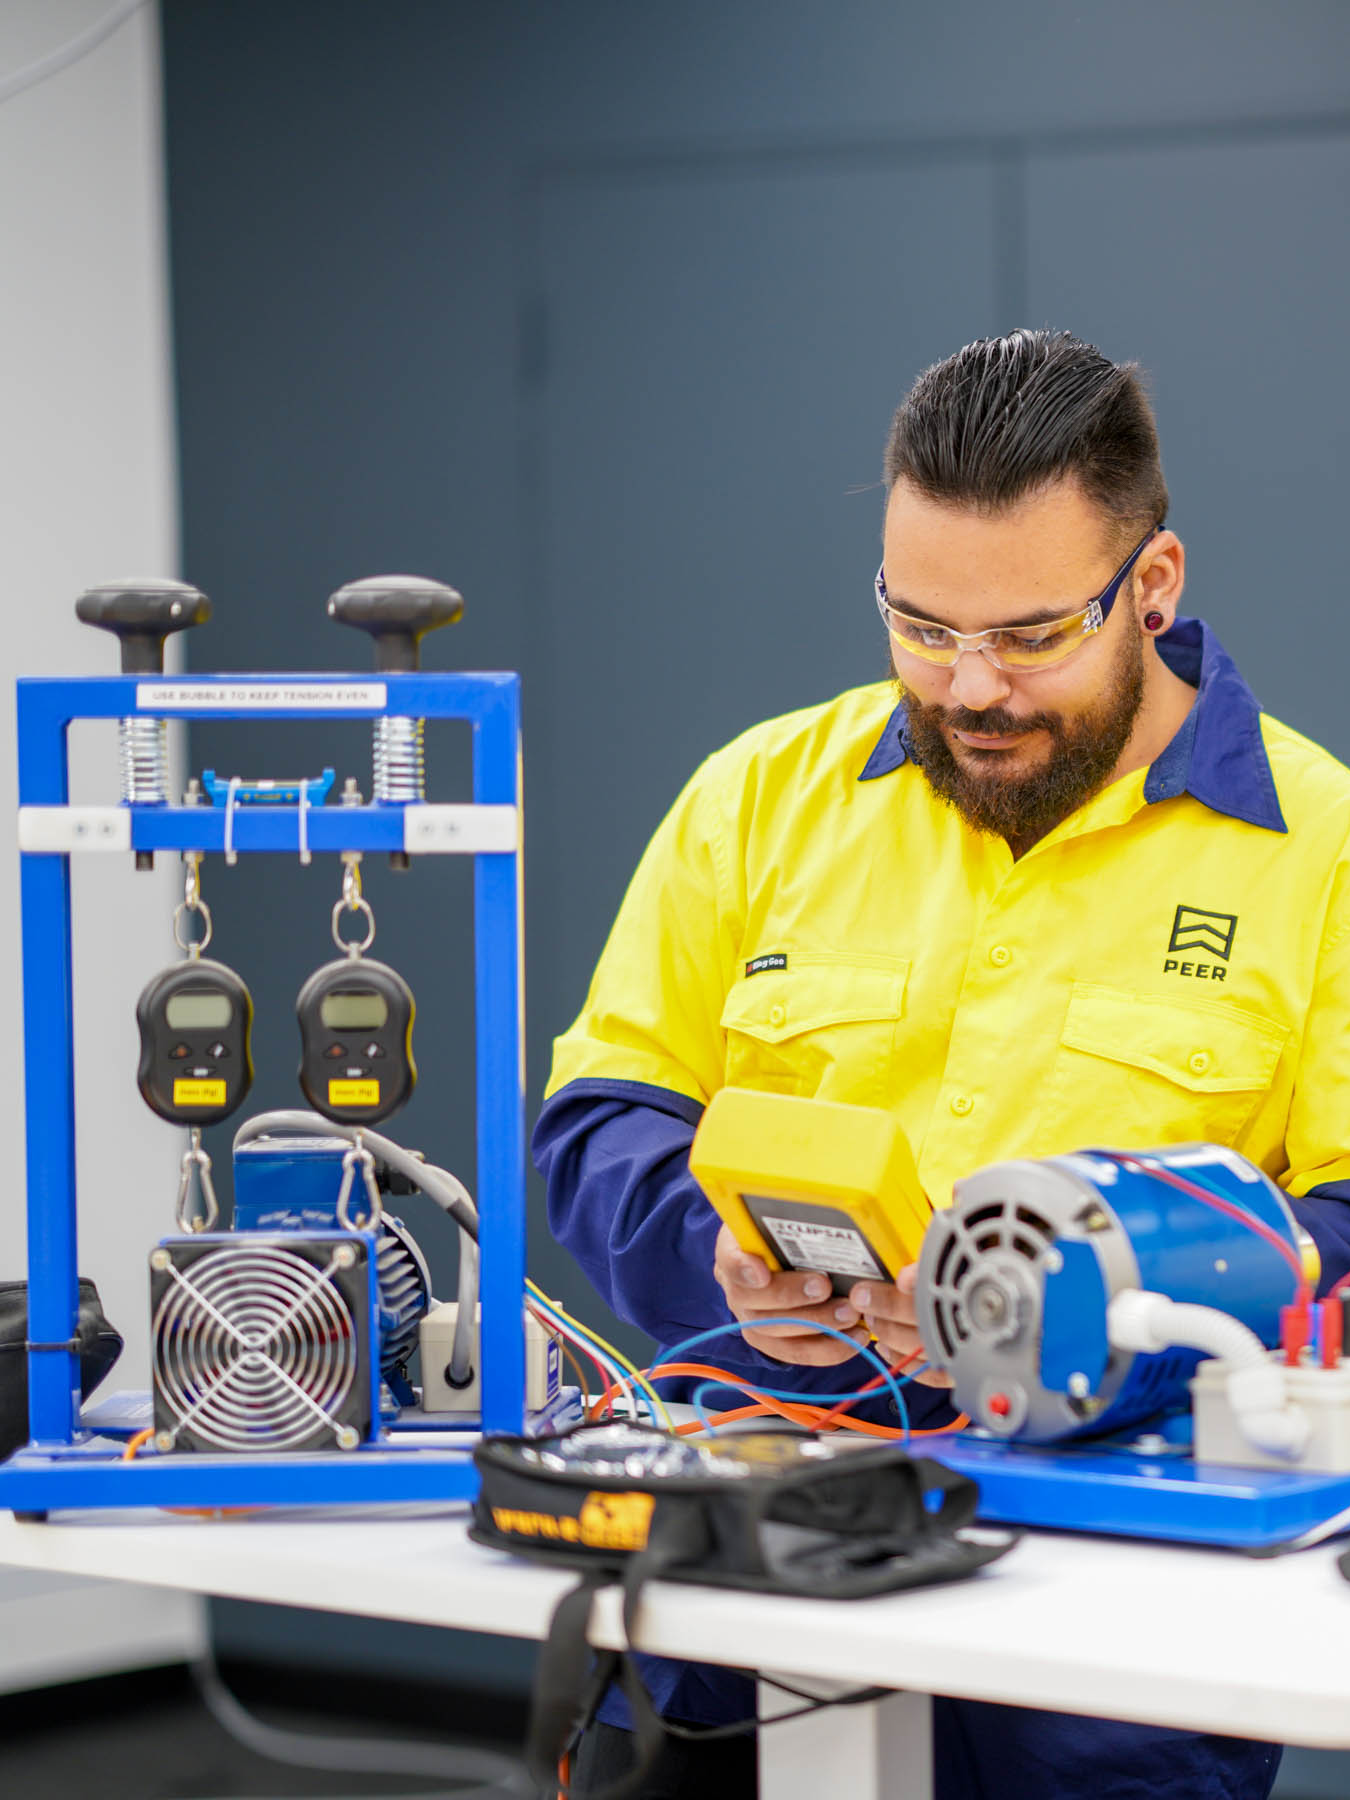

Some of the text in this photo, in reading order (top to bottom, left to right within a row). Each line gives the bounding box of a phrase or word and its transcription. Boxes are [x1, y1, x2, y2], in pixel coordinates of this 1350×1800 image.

[152, 691, 369, 700] USE BUBBLE TO KEEP TENSION EVEN
[1163, 959, 1227, 982] PEER
